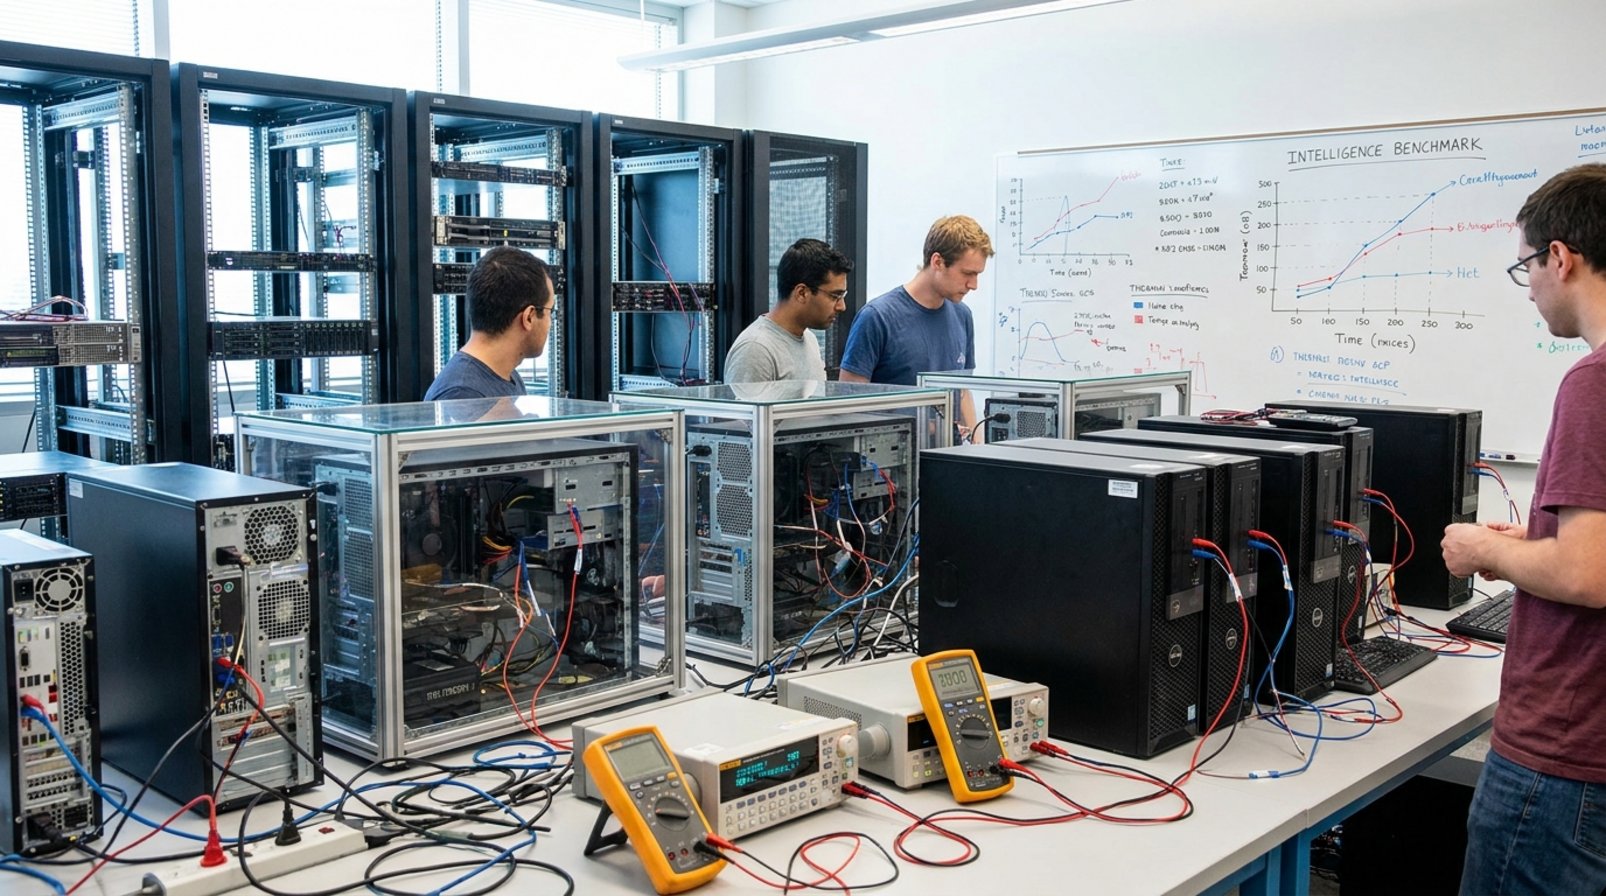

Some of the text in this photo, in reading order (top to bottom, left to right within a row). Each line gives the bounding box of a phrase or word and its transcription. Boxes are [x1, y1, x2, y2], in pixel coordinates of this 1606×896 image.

[1287, 137, 1484, 165] INTELLIGENCE BENCHMARK
[1257, 200, 1272, 209] 250
[1257, 222, 1272, 230] 200
[1256, 243, 1270, 252] 150
[1256, 265, 1269, 273] 100
[1256, 285, 1267, 294] 50
[1290, 317, 1302, 325] 50
[1355, 317, 1370, 326] 150
[1387, 318, 1404, 327] 200
[1421, 319, 1439, 328] 250
[1334, 332, 1363, 346] Time
